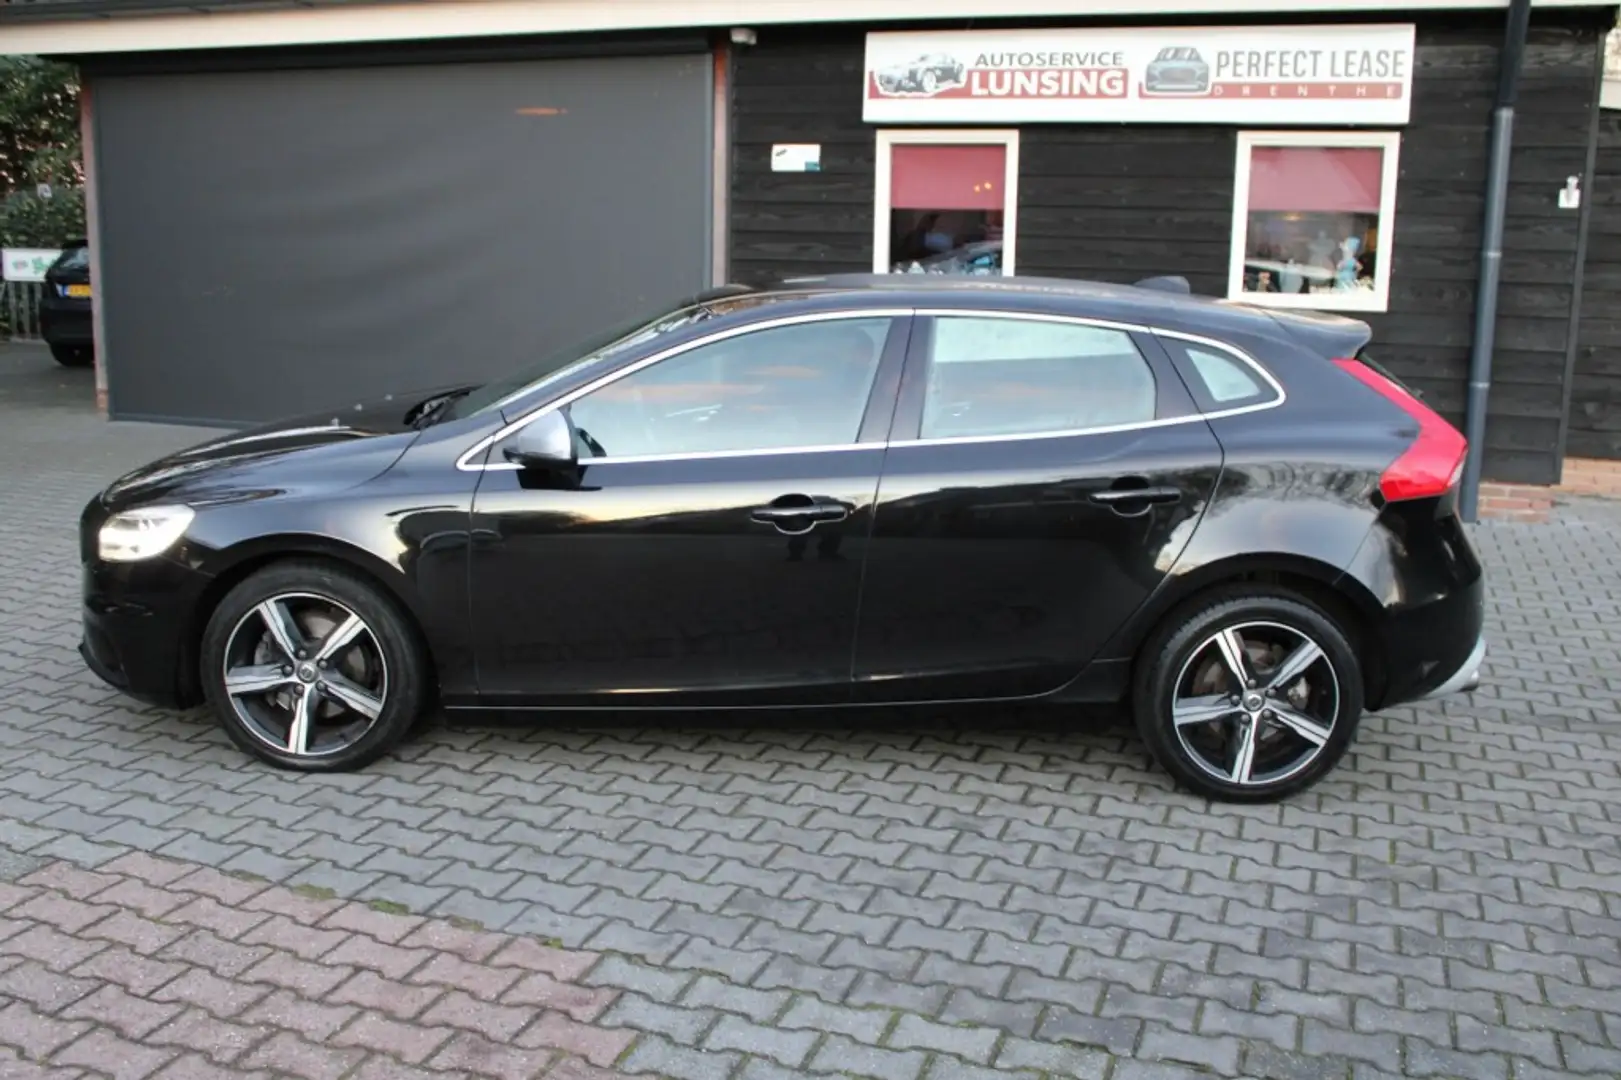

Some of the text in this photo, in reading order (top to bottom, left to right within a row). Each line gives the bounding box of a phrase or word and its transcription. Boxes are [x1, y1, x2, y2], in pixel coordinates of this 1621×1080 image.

[975, 51, 1125, 67] AUTOSERVICE
[1215, 50, 1406, 78] PERFECT LEASE
[971, 70, 1125, 96] LUNSING
[1213, 84, 1397, 97] DRENTHE
